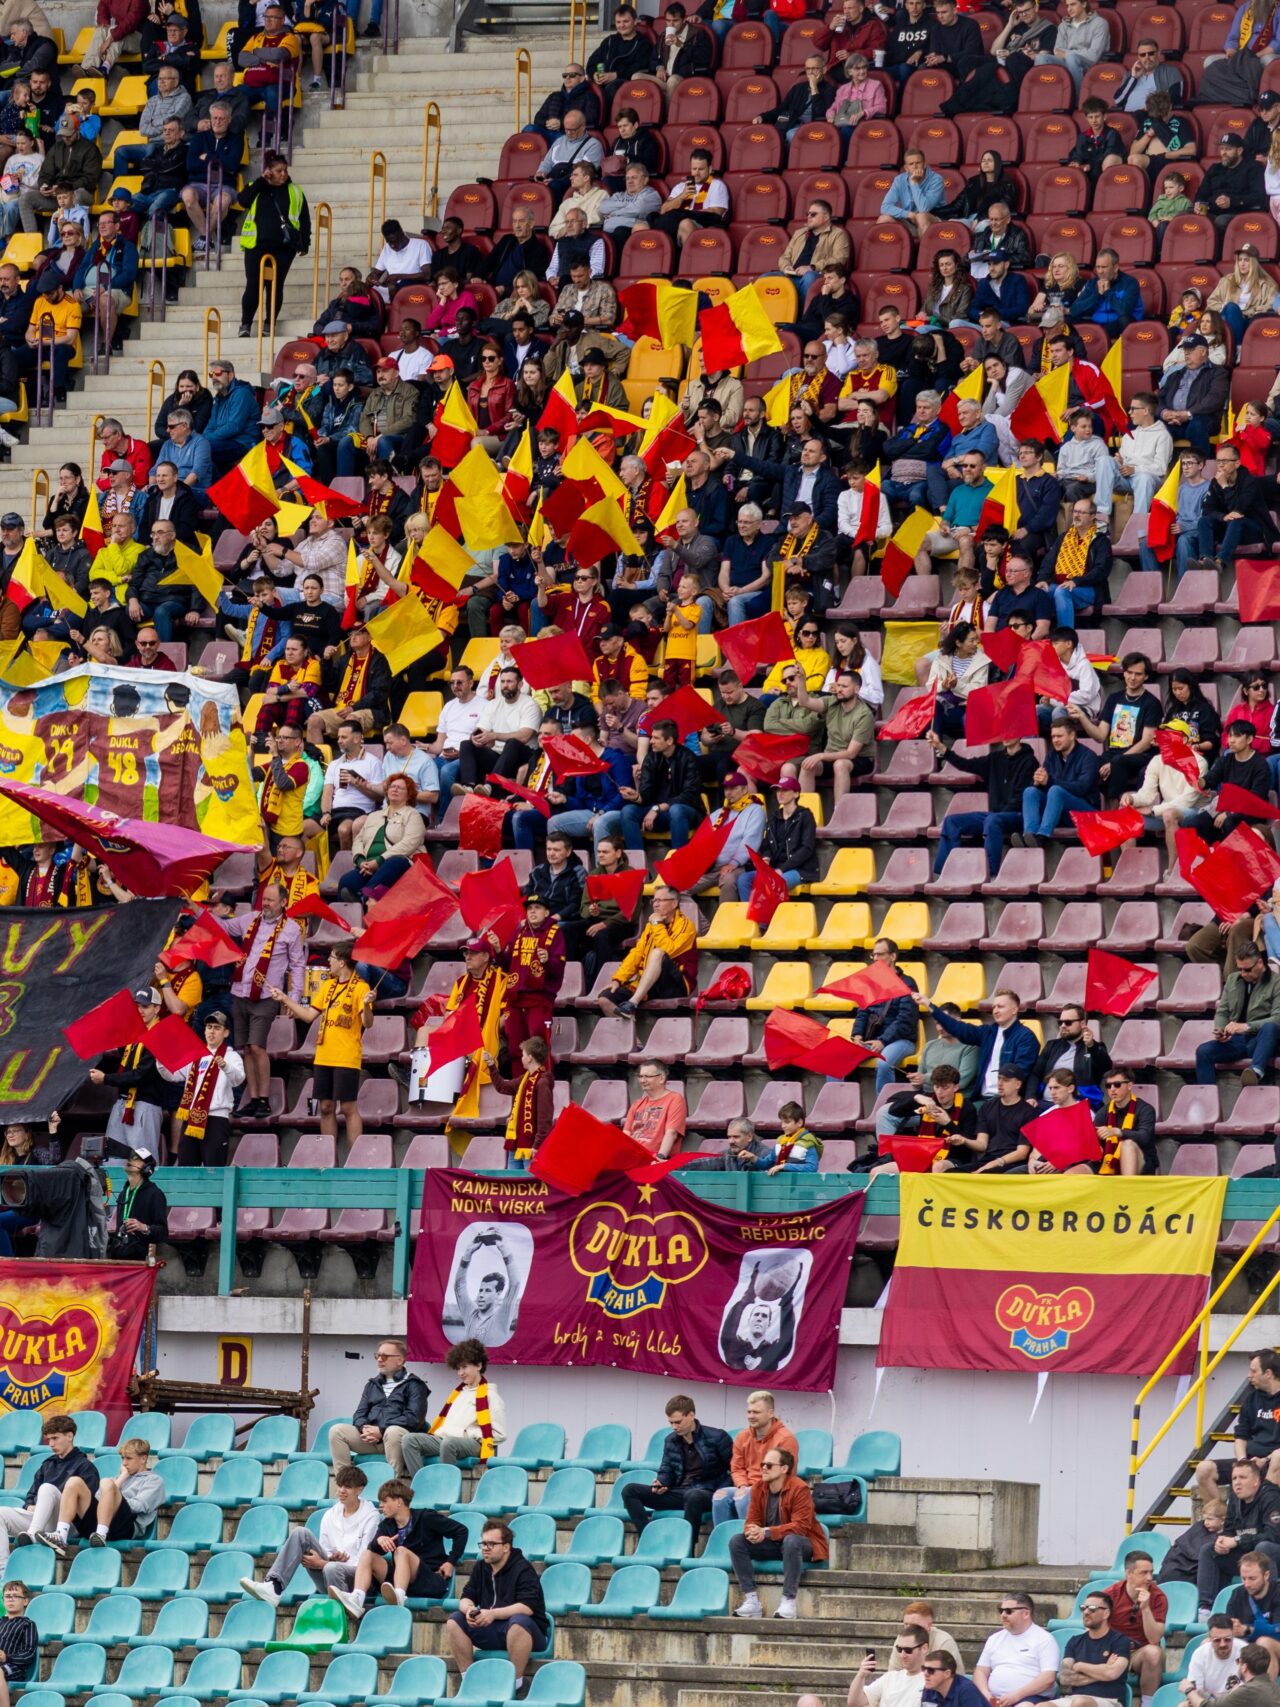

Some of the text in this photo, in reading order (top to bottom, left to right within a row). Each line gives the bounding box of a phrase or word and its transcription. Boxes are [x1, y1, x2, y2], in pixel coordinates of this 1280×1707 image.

[898, 30, 927, 42] BOSS
[109, 736, 139, 749] DUKLA
[108, 752, 139, 785] 48
[523, 1070, 539, 1134] DUKLA
[451, 1198, 546, 1214] NOVÁ VÍSKA
[918, 1198, 1195, 1235] ČESKOBROĎÁCI
[586, 1221, 692, 1267] DUKLA
[740, 1226, 826, 1241] REPUBLIC
[604, 1288, 647, 1310] RAHA
[1006, 1296, 1083, 1326] DUKLA
[553, 1322, 587, 1358] hrdý
[613, 1330, 640, 1358] svůj
[646, 1329, 682, 1356] klub
[1022, 1337, 1058, 1354] PRAHA
[221, 1342, 248, 1387] D
[2, 1382, 52, 1404] PRAHA
